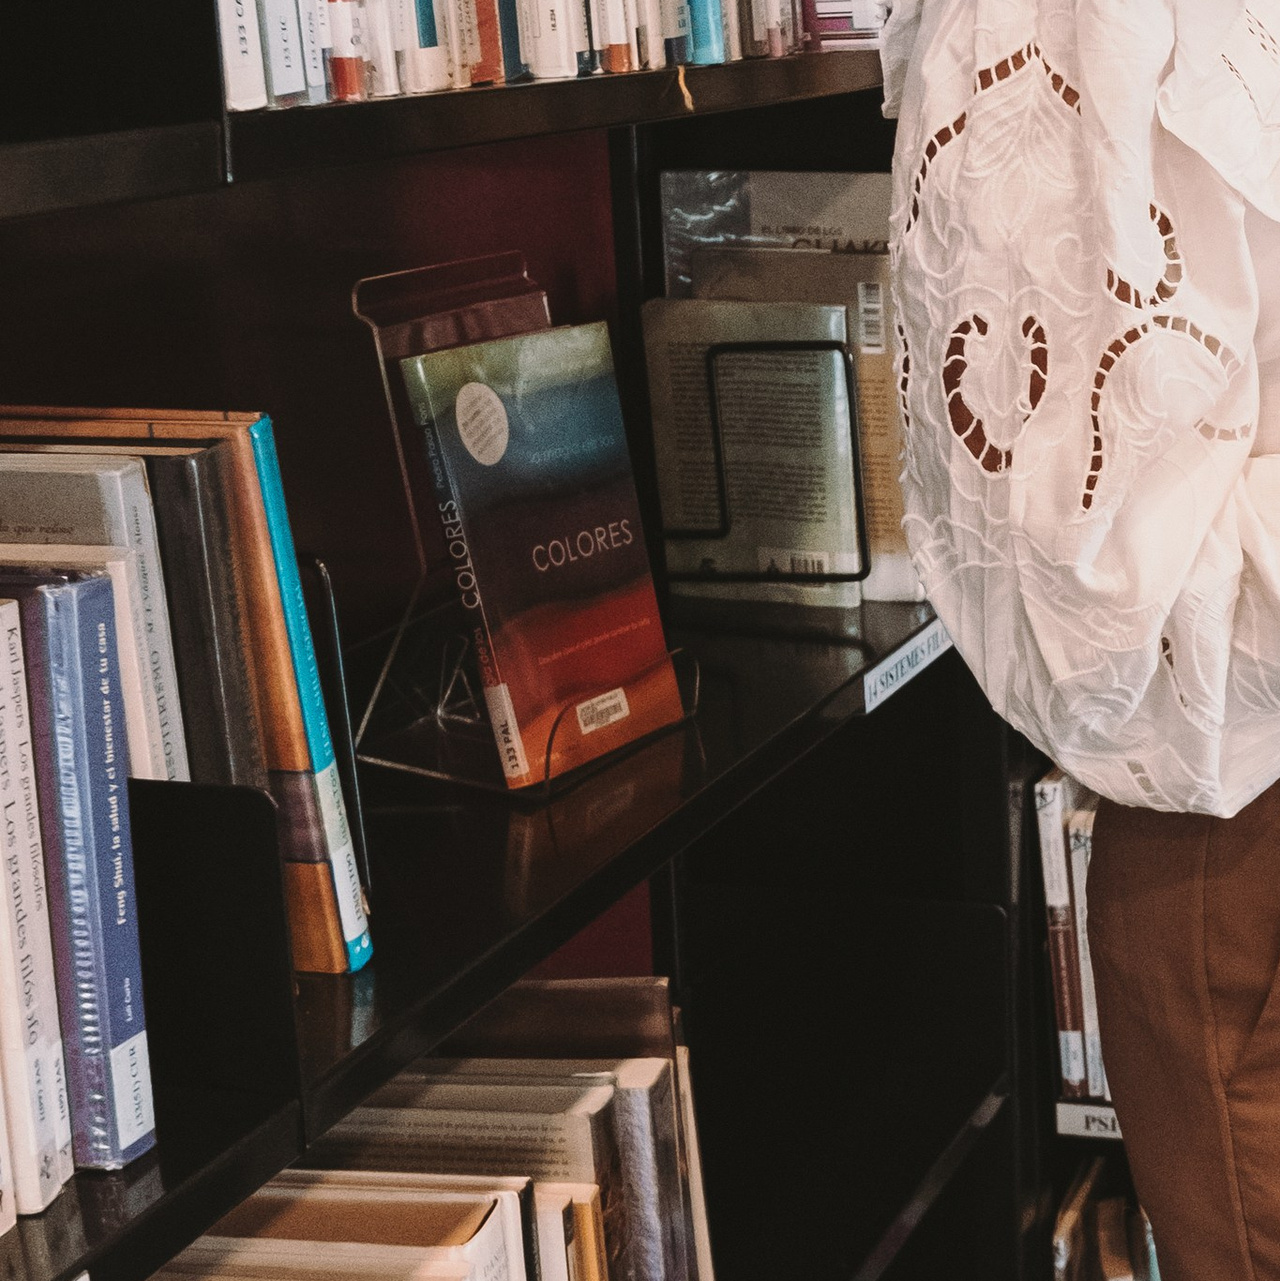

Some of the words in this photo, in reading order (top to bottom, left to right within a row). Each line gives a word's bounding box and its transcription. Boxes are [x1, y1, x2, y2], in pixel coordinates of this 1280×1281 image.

[237, 25, 249, 56] 133
[131, 505, 144, 545] Alonso
[442, 496, 483, 610] COLORES
[533, 519, 635, 573] COLORES
[6, 626, 21, 664] Karl
[97, 621, 107, 653] casa
[98, 657, 108, 673] tu
[8, 668, 24, 730] Jaspers
[100, 677, 111, 694] de
[102, 699, 115, 764] bienestar
[151, 650, 177, 781] ESOTERISMO
[500, 720, 513, 744] PAL
[19, 740, 31, 771] Los
[106, 767, 115, 779] el
[506, 747, 519, 770] 133
[3, 799, 19, 849] Los
[20, 776, 37, 841] grandes
[108, 795, 119, 832] salud
[111, 835, 120, 849] la
[28, 841, 46, 912] filósofos
[112, 852, 125, 889] Shui,
[7, 856, 29, 950] grandes
[114, 891, 128, 926] Feng
